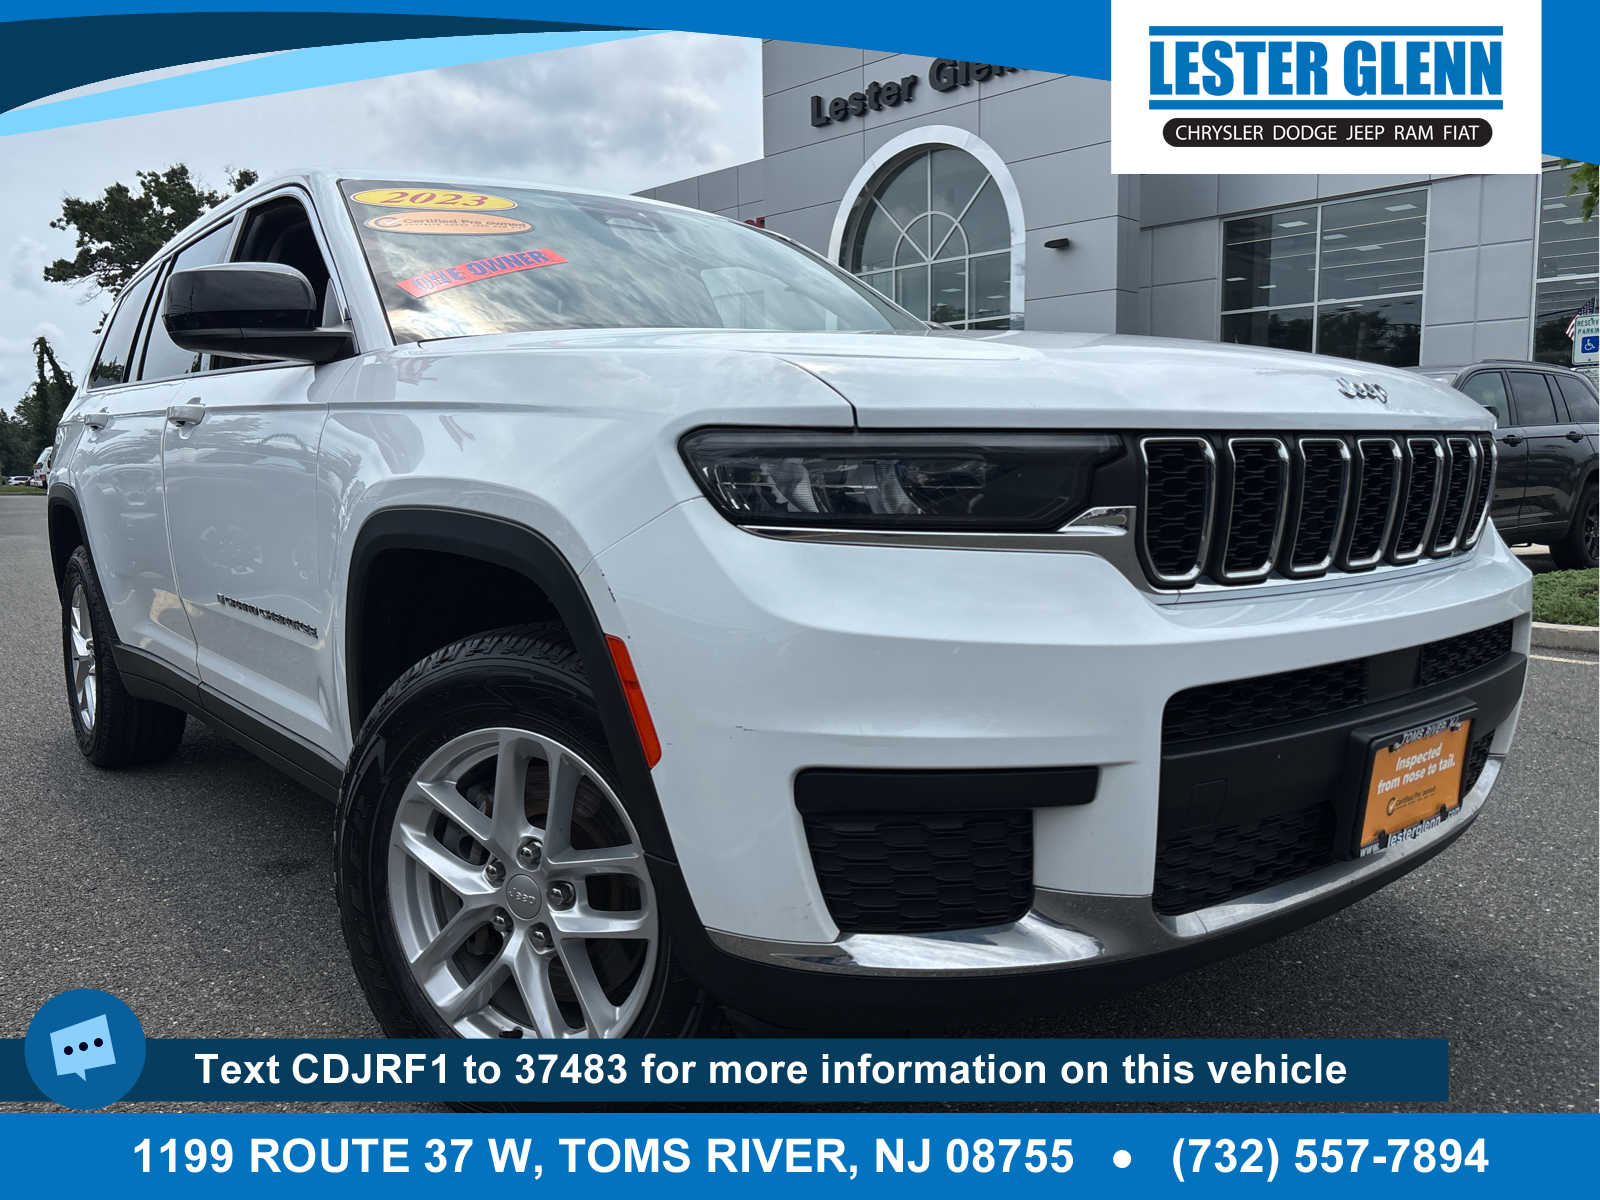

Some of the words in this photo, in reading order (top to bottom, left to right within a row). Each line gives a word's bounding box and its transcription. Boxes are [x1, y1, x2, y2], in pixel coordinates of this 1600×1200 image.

[811, 74, 919, 127] Lester
[929, 57, 1027, 92] Gle
[380, 191, 489, 208] 2023
[412, 267, 466, 292] ONE
[466, 250, 550, 276] OWNER
[1336, 377, 1388, 404] Jeep
[1377, 775, 1401, 795] from
[1402, 768, 1426, 785] nose
[1427, 762, 1437, 776] to
[1439, 752, 1456, 771] tail.
[1395, 742, 1443, 771] Inspected
